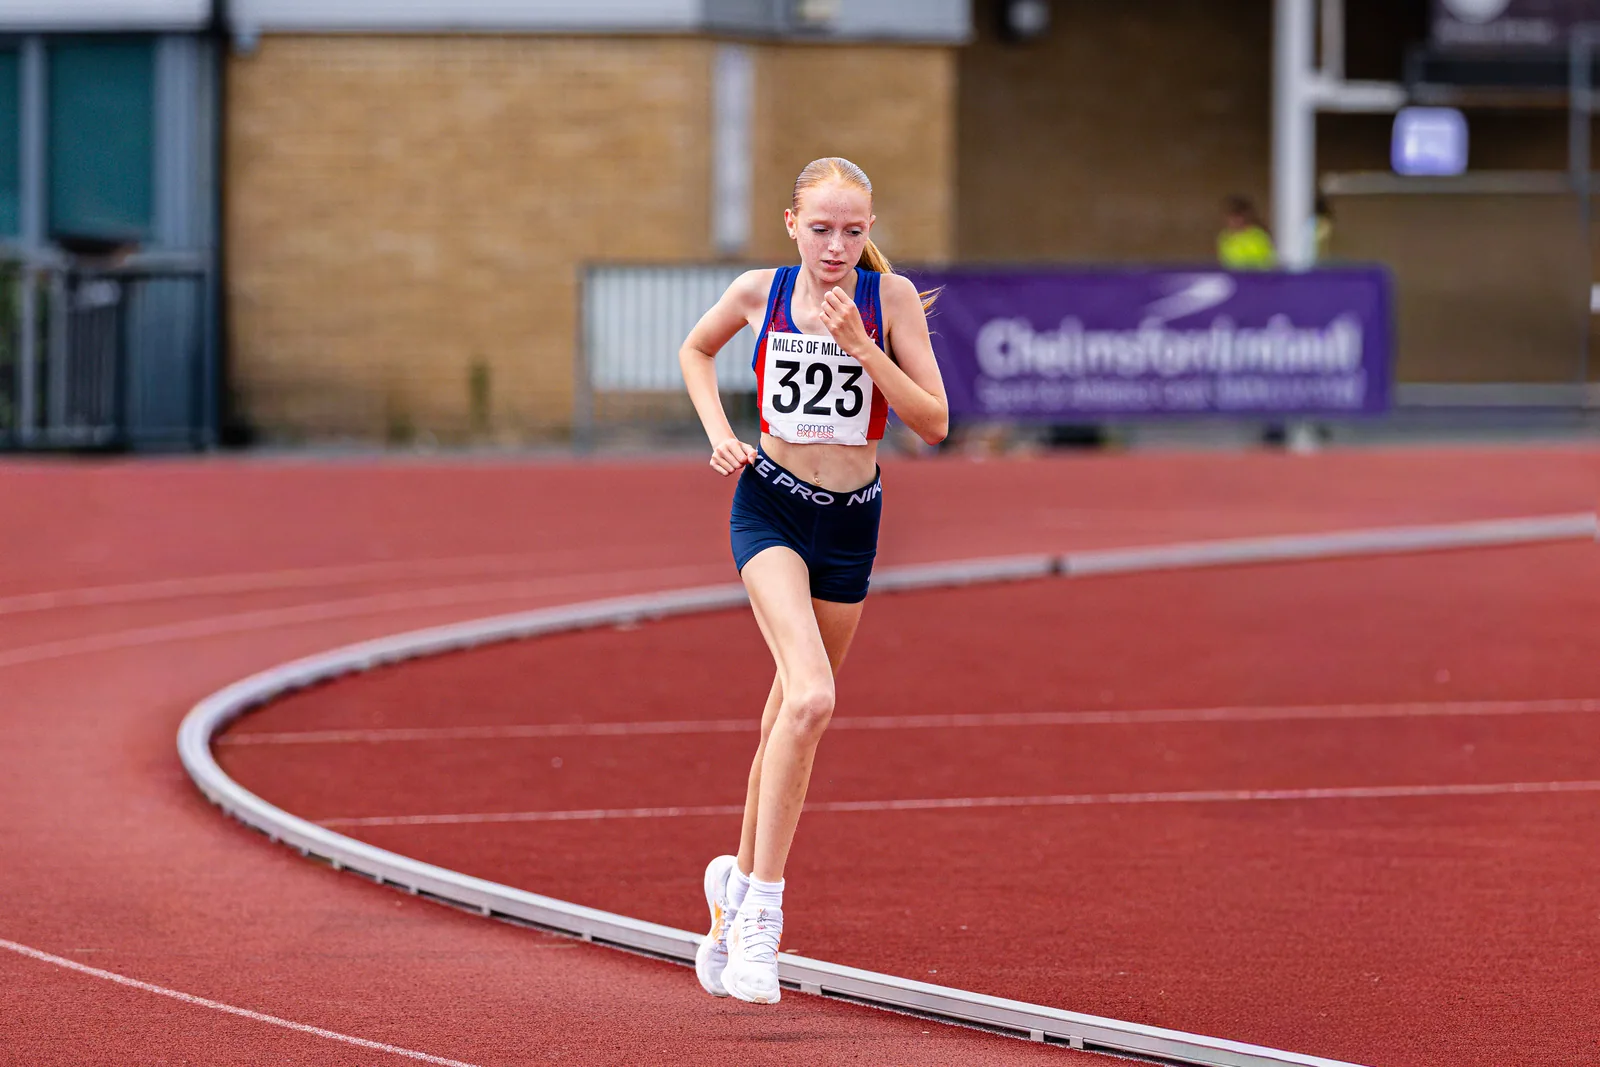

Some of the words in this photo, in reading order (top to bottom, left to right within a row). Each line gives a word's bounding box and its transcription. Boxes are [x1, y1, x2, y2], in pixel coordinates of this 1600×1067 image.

[772, 338, 804, 354] MILES
[805, 340, 820, 355] OF
[772, 360, 864, 418] 323
[796, 423, 835, 434] comms
[796, 430, 834, 439] express
[772, 472, 835, 506] PRO
